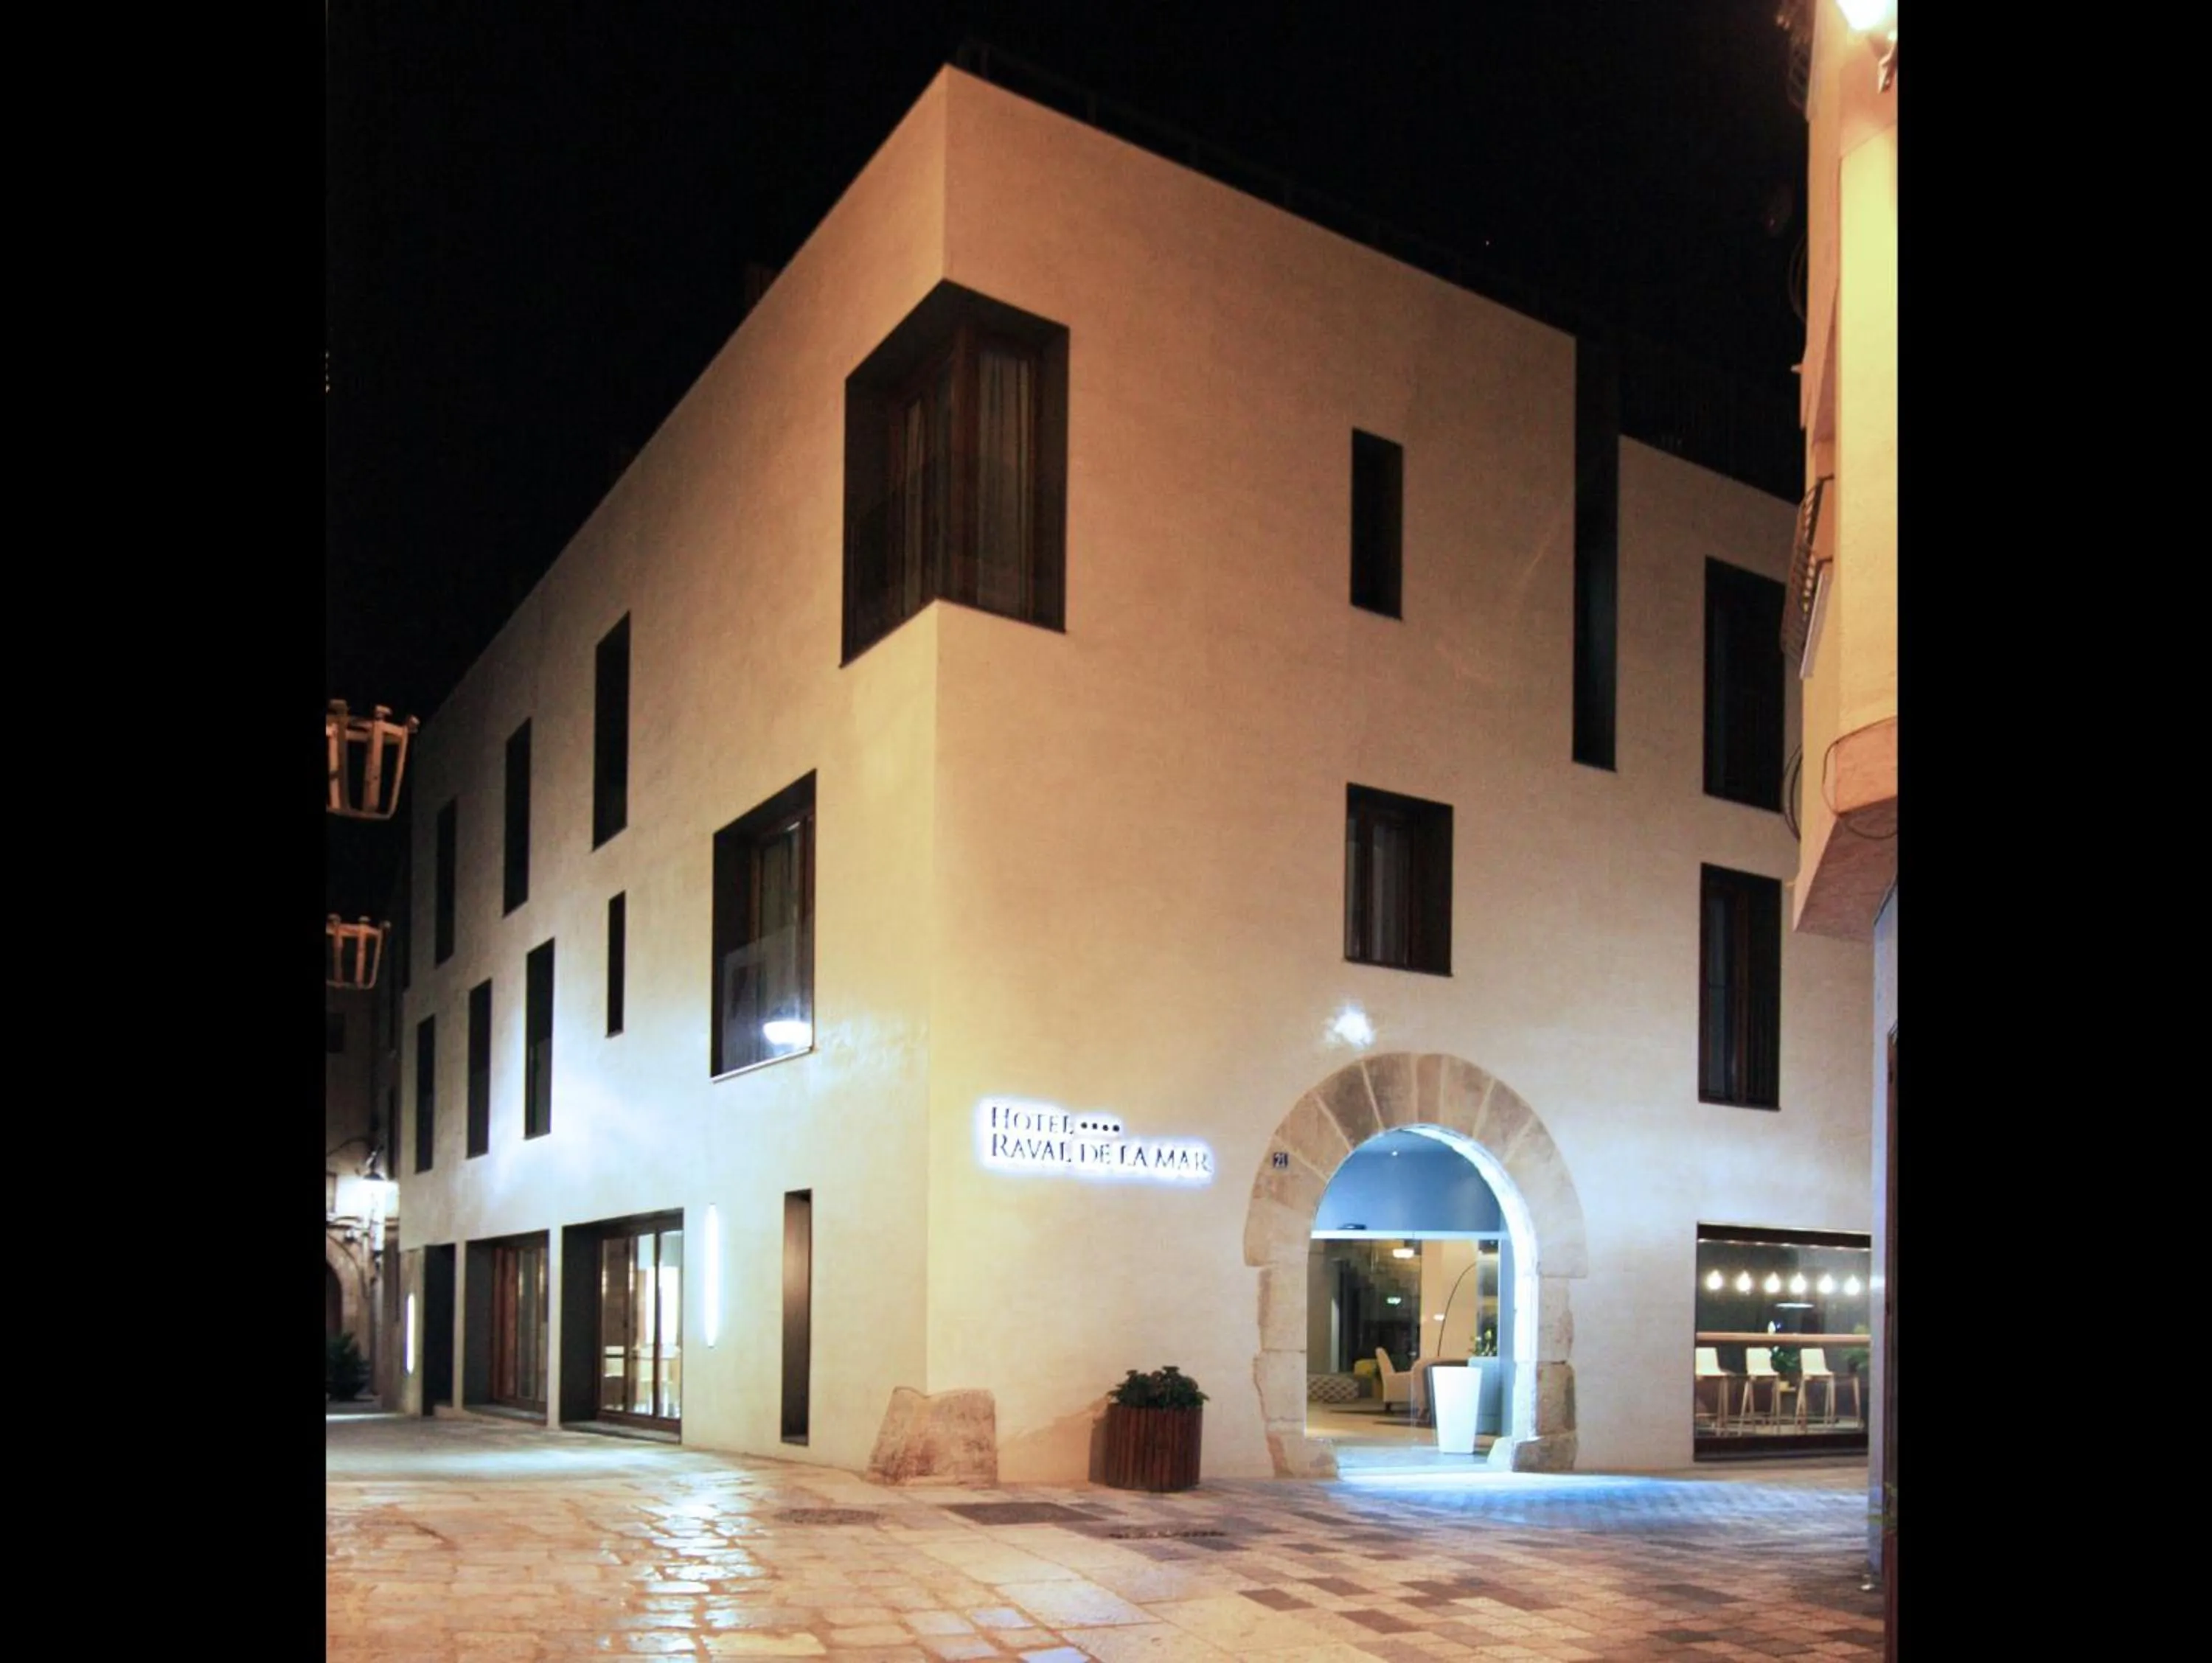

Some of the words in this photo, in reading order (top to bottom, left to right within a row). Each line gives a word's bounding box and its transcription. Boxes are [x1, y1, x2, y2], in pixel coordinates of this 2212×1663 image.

[991, 1106, 1074, 1135] HOTEL
[991, 1133, 1072, 1163] RAVAL
[1080, 1143, 1111, 1165] DE
[1119, 1144, 1149, 1168] LA
[1154, 1147, 1213, 1174] MAR
